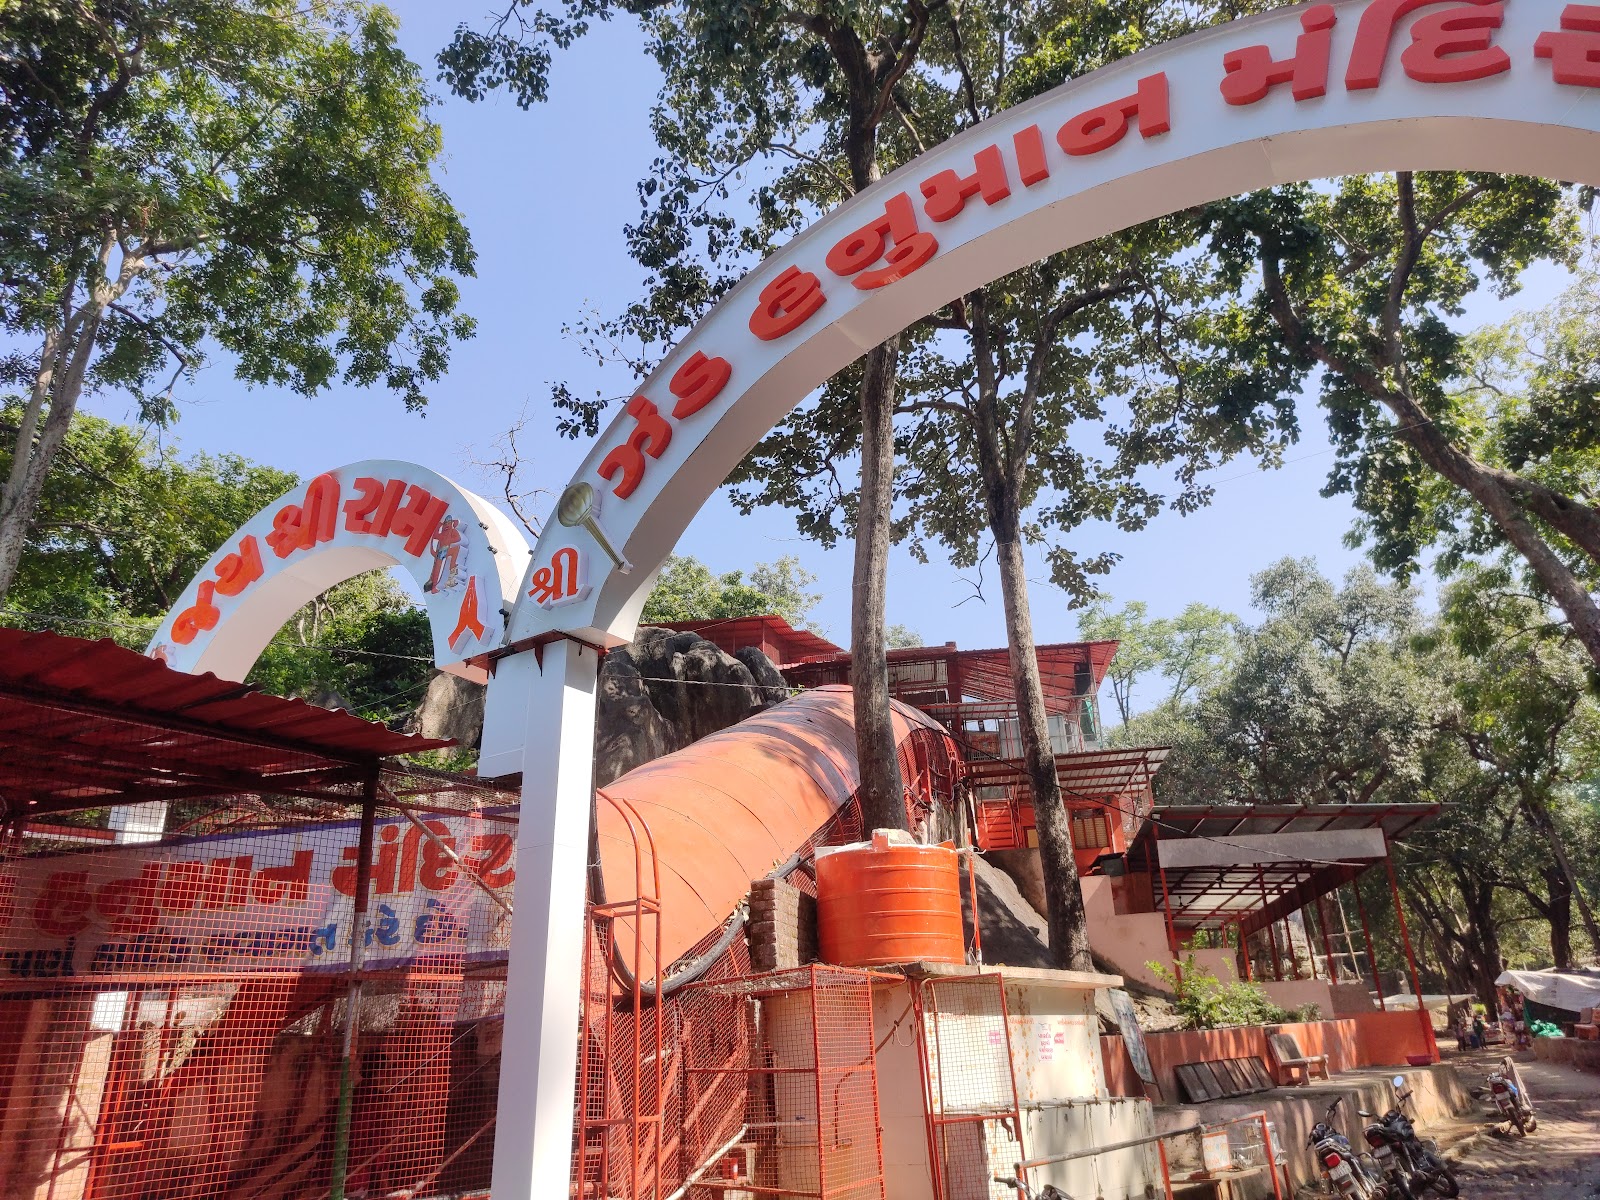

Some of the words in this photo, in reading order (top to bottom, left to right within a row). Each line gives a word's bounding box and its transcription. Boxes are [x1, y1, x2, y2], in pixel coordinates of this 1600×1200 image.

[530, 547, 580, 605] શ્રી
[748, 71, 1171, 342] હનુમાન
[170, 534, 265, 645] જય
[265, 473, 341, 559] શ્રી
[343, 477, 451, 558] રામ
[32, 850, 314, 937] હનુમાન
[331, 820, 516, 897] મંદિર
[201, 923, 338, 962] સ્વાગત
